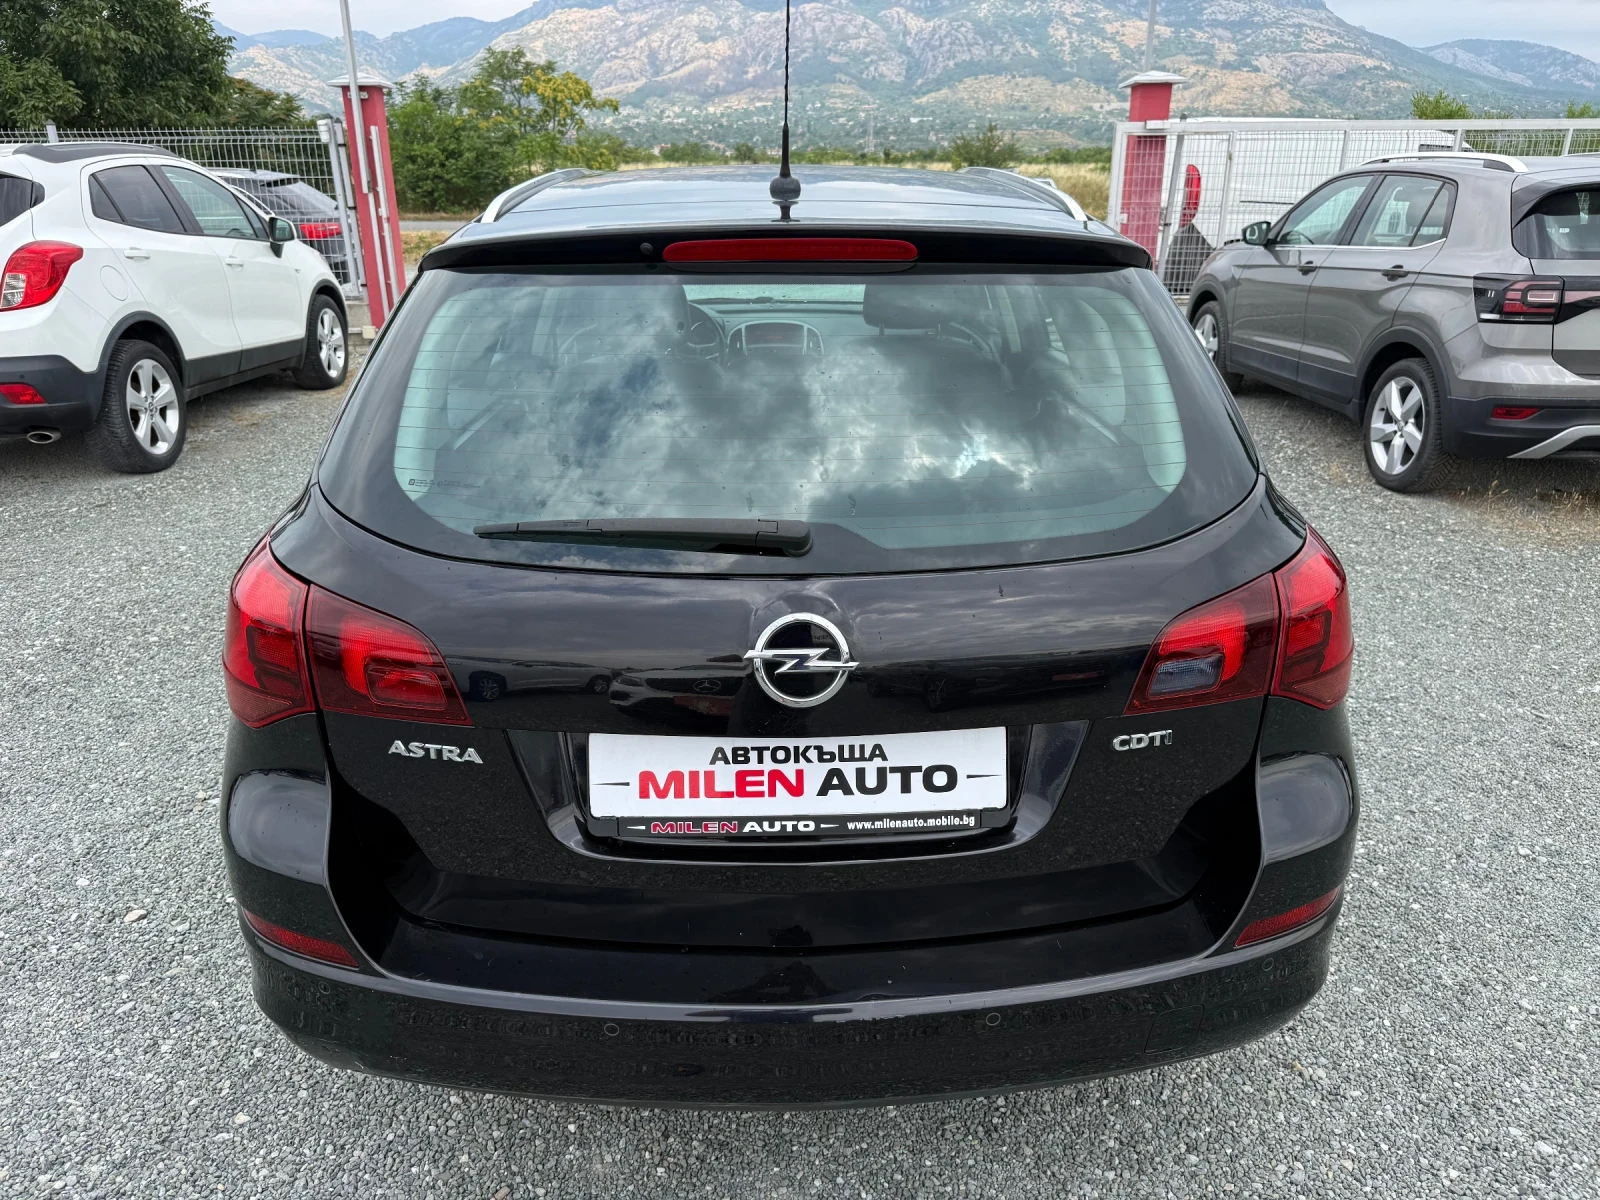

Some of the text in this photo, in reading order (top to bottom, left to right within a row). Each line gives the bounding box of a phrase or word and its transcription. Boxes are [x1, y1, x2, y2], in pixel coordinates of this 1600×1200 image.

[388, 740, 483, 764] ASTRA
[709, 743, 888, 765] АВТОКЪЩА
[638, 764, 958, 799] MILEN AUTO
[650, 815, 975, 834] MILEN AUTO www.milenauto.mobile.bg
